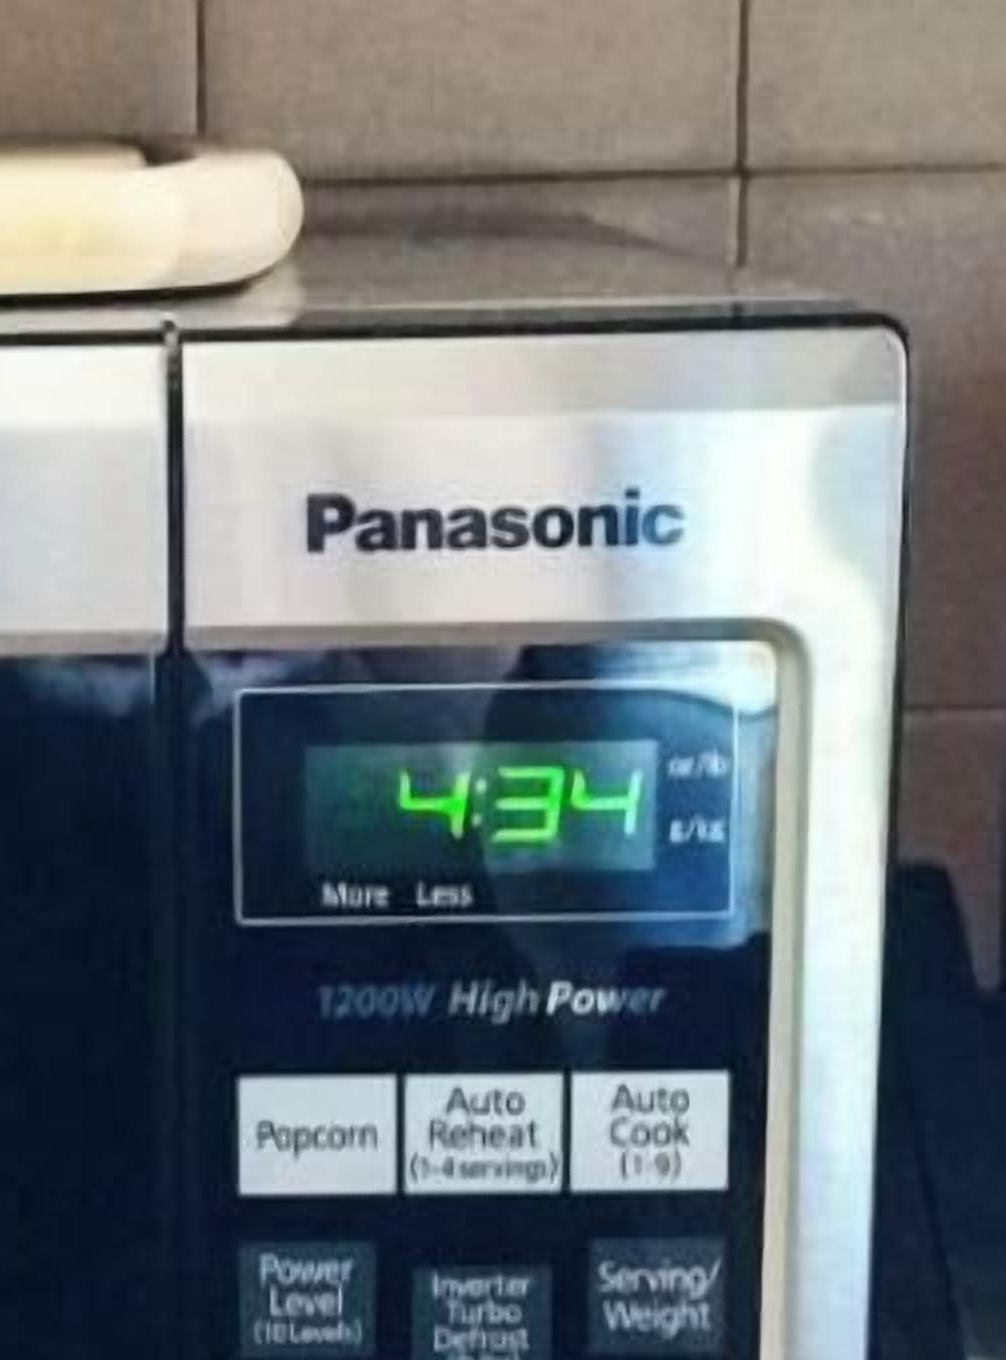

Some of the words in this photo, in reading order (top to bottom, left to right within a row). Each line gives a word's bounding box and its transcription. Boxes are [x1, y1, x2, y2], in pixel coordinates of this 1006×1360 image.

[306, 488, 684, 553] Panasonic
[398, 765, 642, 841] 4:34
[322, 882, 389, 909] More
[416, 882, 474, 909] Less
[316, 984, 436, 1020] 1200W
[447, 979, 539, 1026] High
[545, 980, 667, 1017] Power
[445, 1087, 527, 1117] Auto
[611, 1084, 691, 1114] Auto
[256, 1120, 378, 1158] Popcorn
[428, 1119, 538, 1150] Reheat
[609, 1115, 691, 1148] Cook
[258, 1253, 354, 1287] Power
[432, 1272, 531, 1299] Inverter
[597, 1258, 722, 1302] Serving/
[269, 1287, 344, 1317] Level
[445, 1301, 523, 1325] Turbo
[602, 1301, 712, 1338] Weight
[432, 1326, 530, 1352] Defrost
